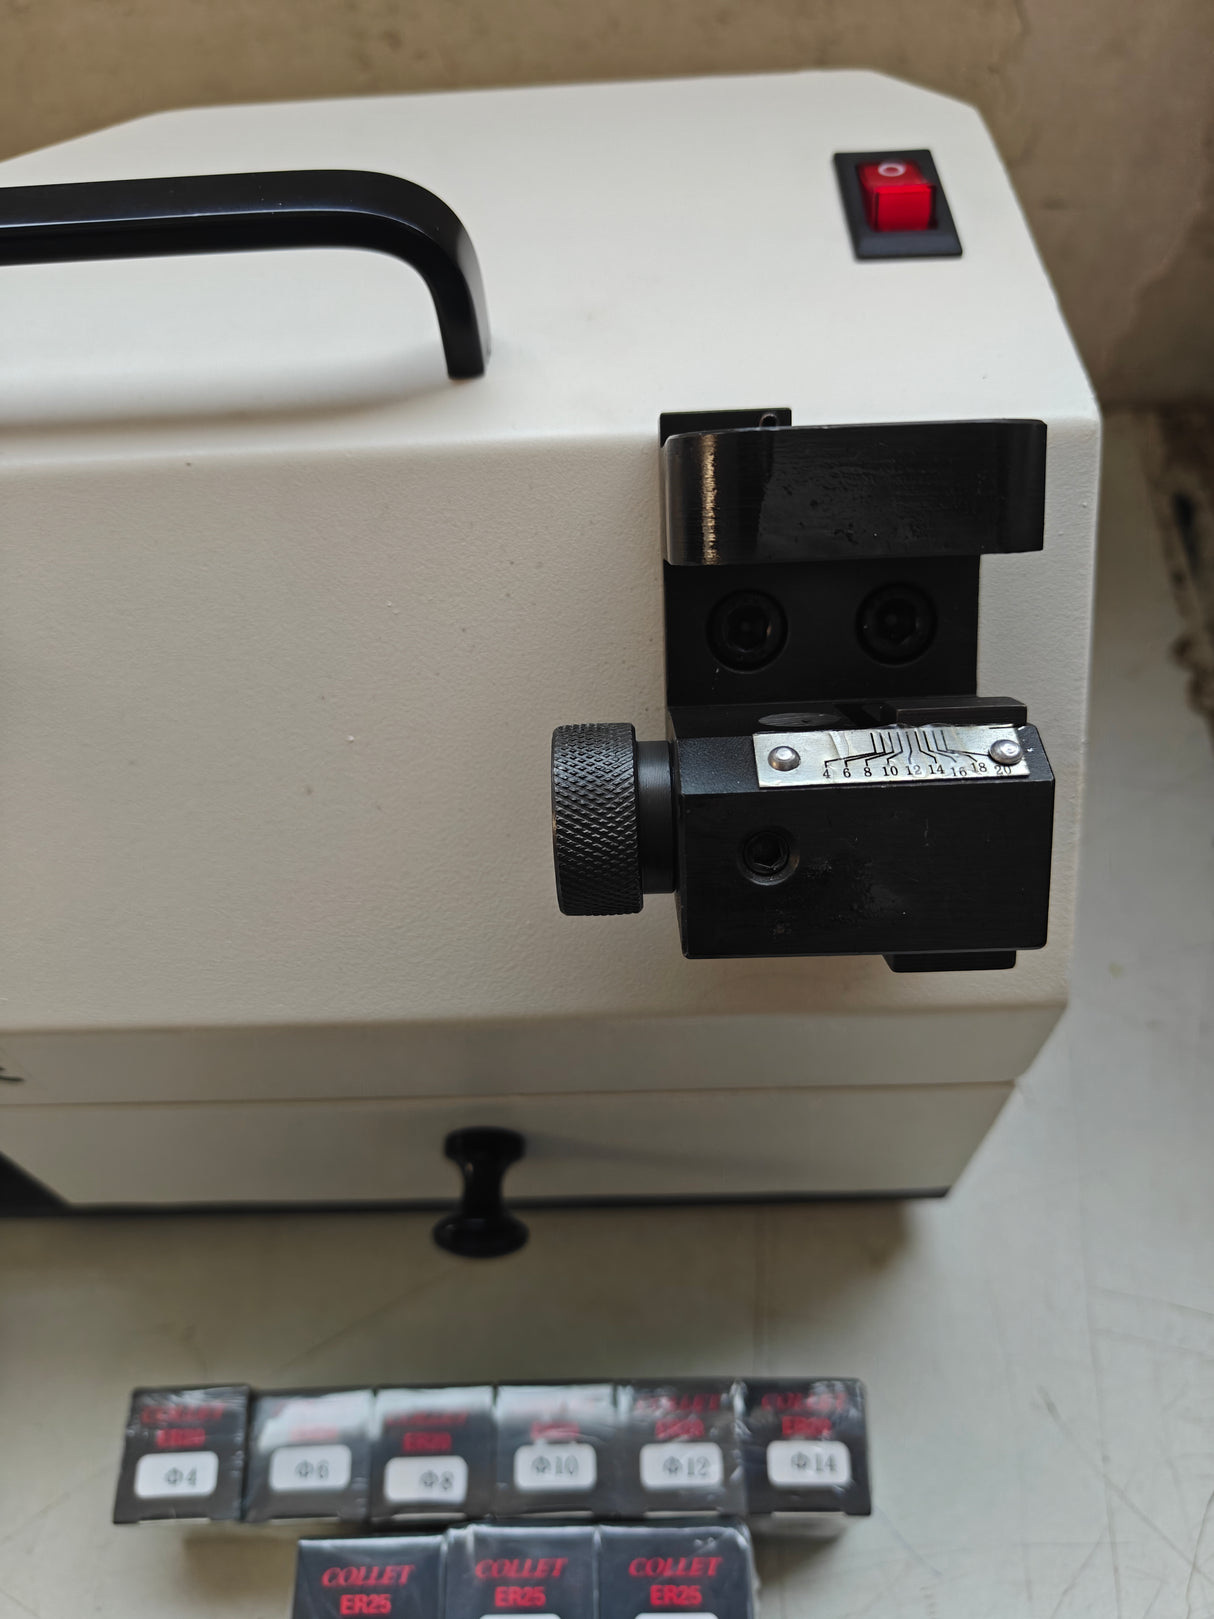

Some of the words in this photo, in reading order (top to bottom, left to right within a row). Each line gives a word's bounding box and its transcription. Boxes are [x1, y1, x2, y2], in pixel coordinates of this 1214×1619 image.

[822, 768, 831, 779] 4
[843, 768, 851, 778] 6
[864, 767, 872, 777] 8
[883, 765, 899, 776] 10
[906, 764, 921, 775] 12
[929, 763, 945, 775] 14
[951, 766, 967, 777] 16
[971, 762, 988, 773] 18
[994, 764, 1012, 776] 20
[321, 1564, 416, 1589] COLLET
[475, 1557, 568, 1579] COLLET
[628, 1555, 723, 1577] COLLET
[339, 1593, 392, 1616] ER25
[494, 1585, 547, 1608] ER25
[649, 1583, 703, 1607] ER25
